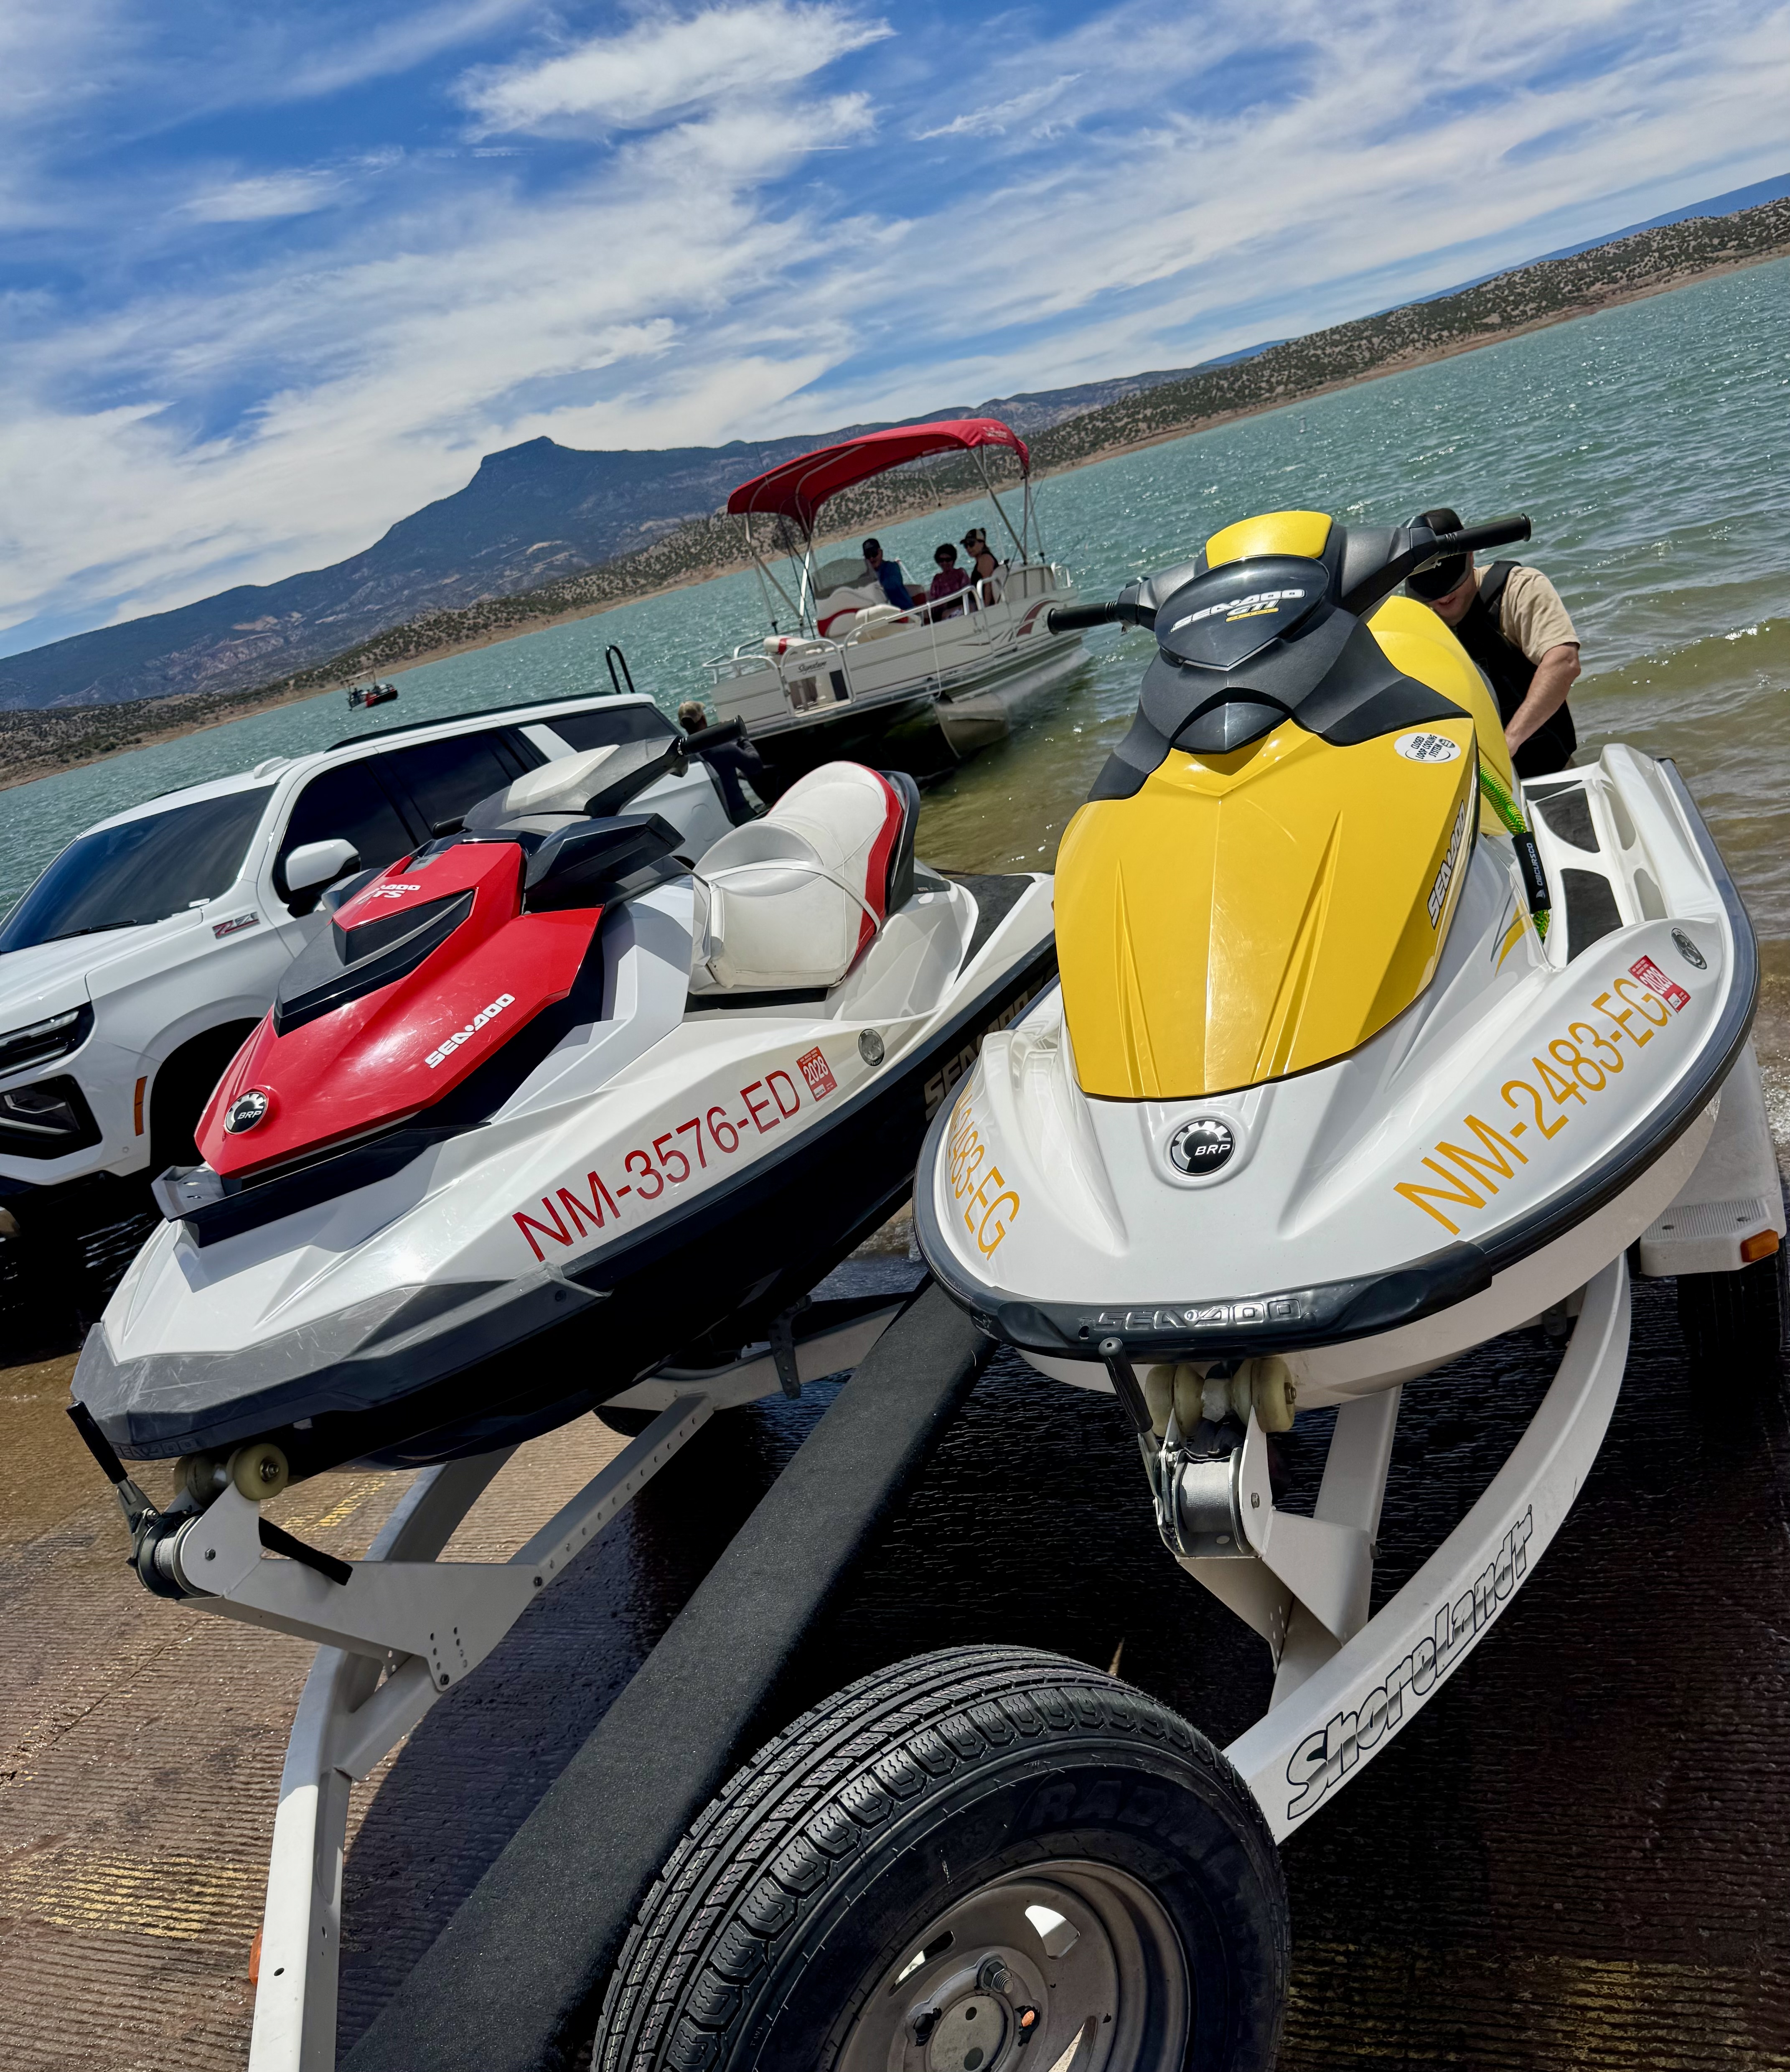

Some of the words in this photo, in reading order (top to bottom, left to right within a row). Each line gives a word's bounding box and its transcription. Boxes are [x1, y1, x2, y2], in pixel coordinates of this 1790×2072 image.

[1227, 599, 1279, 616] GTI
[1411, 736, 1424, 749] CLOSED
[1416, 748, 1427, 759] LOOP
[1422, 734, 1437, 749] COOLING
[1429, 743, 1442, 757] SYSTEM
[1526, 843, 1543, 886] OBCURSCO
[212, 911, 261, 939] Z71
[1643, 967, 1672, 995] 2028
[803, 1055, 829, 1086] 2028
[237, 1110, 262, 1120] BRP
[1393, 977, 1673, 1236] NM-2483-EG
[1194, 1144, 1231, 1156] BRP
[512, 1069, 801, 1262] NM-3576-ED
